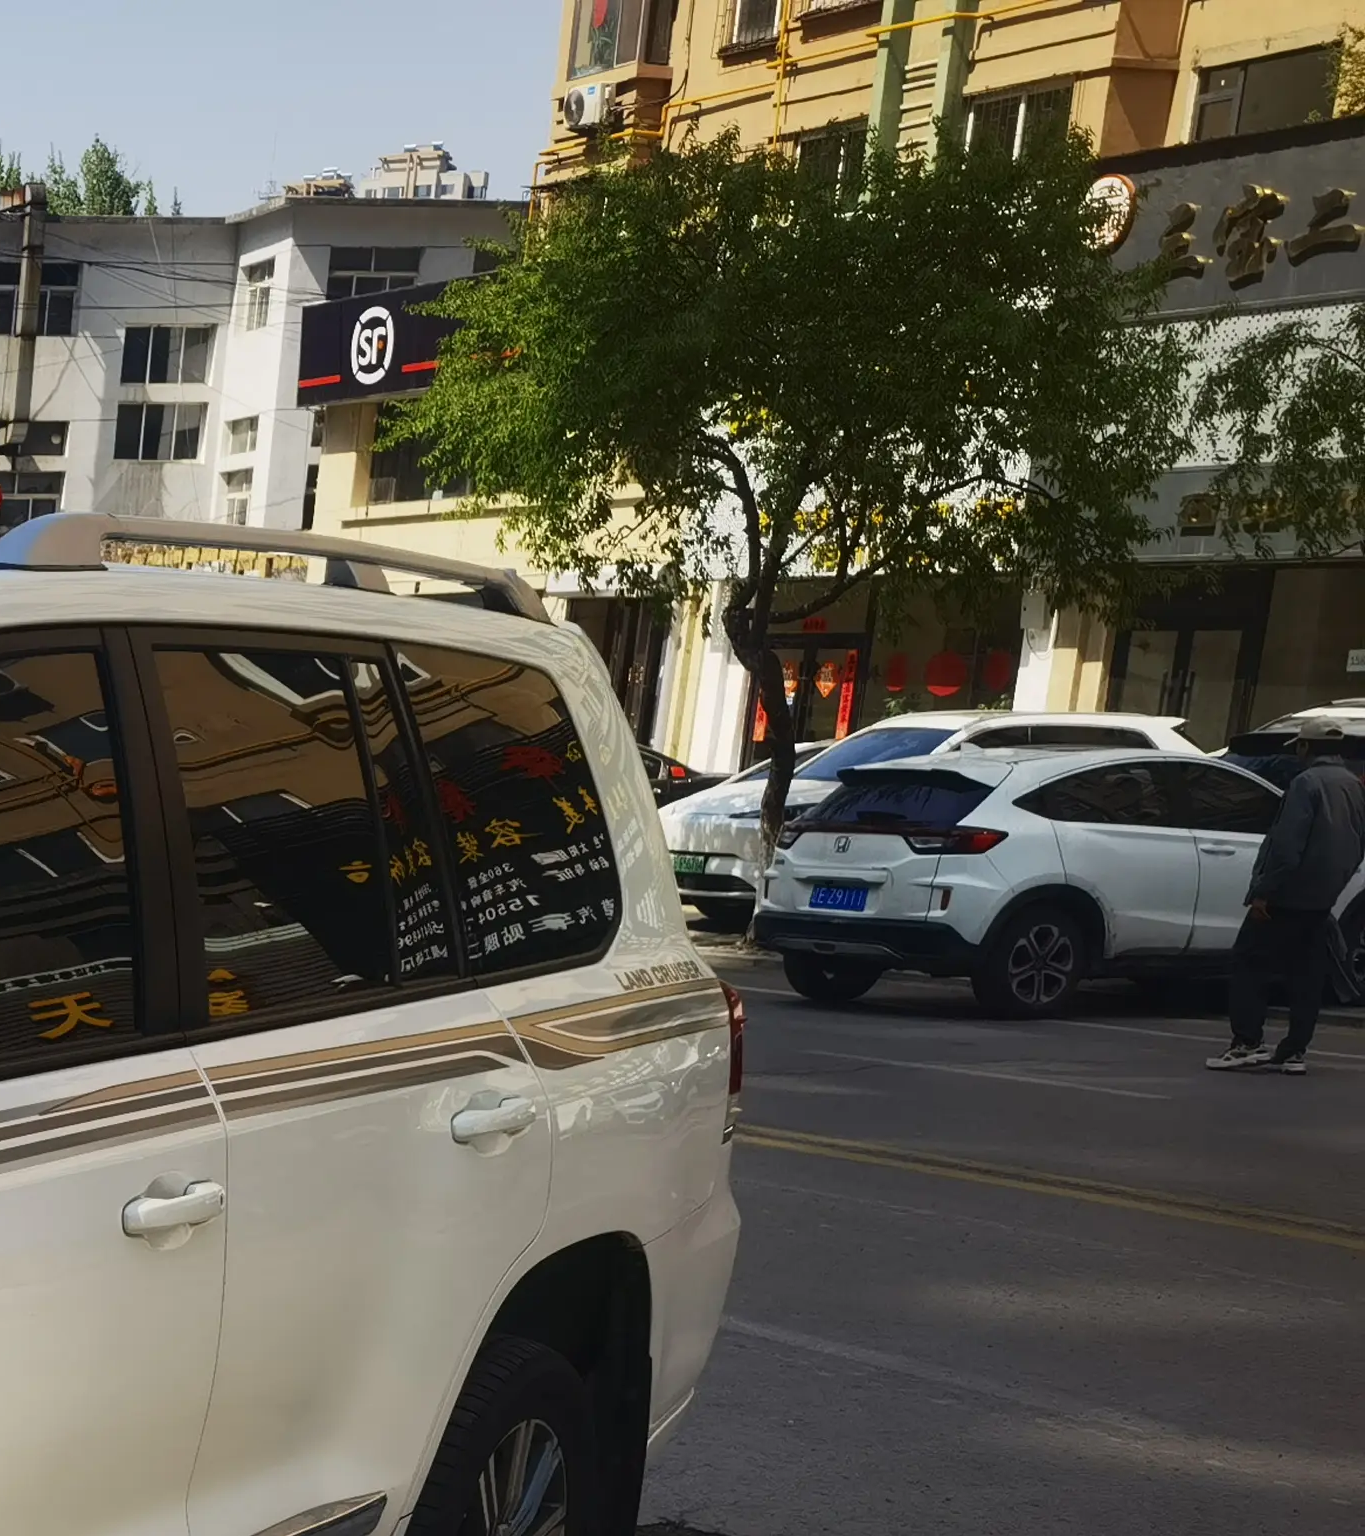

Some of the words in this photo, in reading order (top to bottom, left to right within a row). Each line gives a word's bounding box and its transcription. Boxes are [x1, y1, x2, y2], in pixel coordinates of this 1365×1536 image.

[358, 326, 387, 366] SF
[614, 967, 656, 991] LAND
[649, 960, 704, 985] CRUISER
